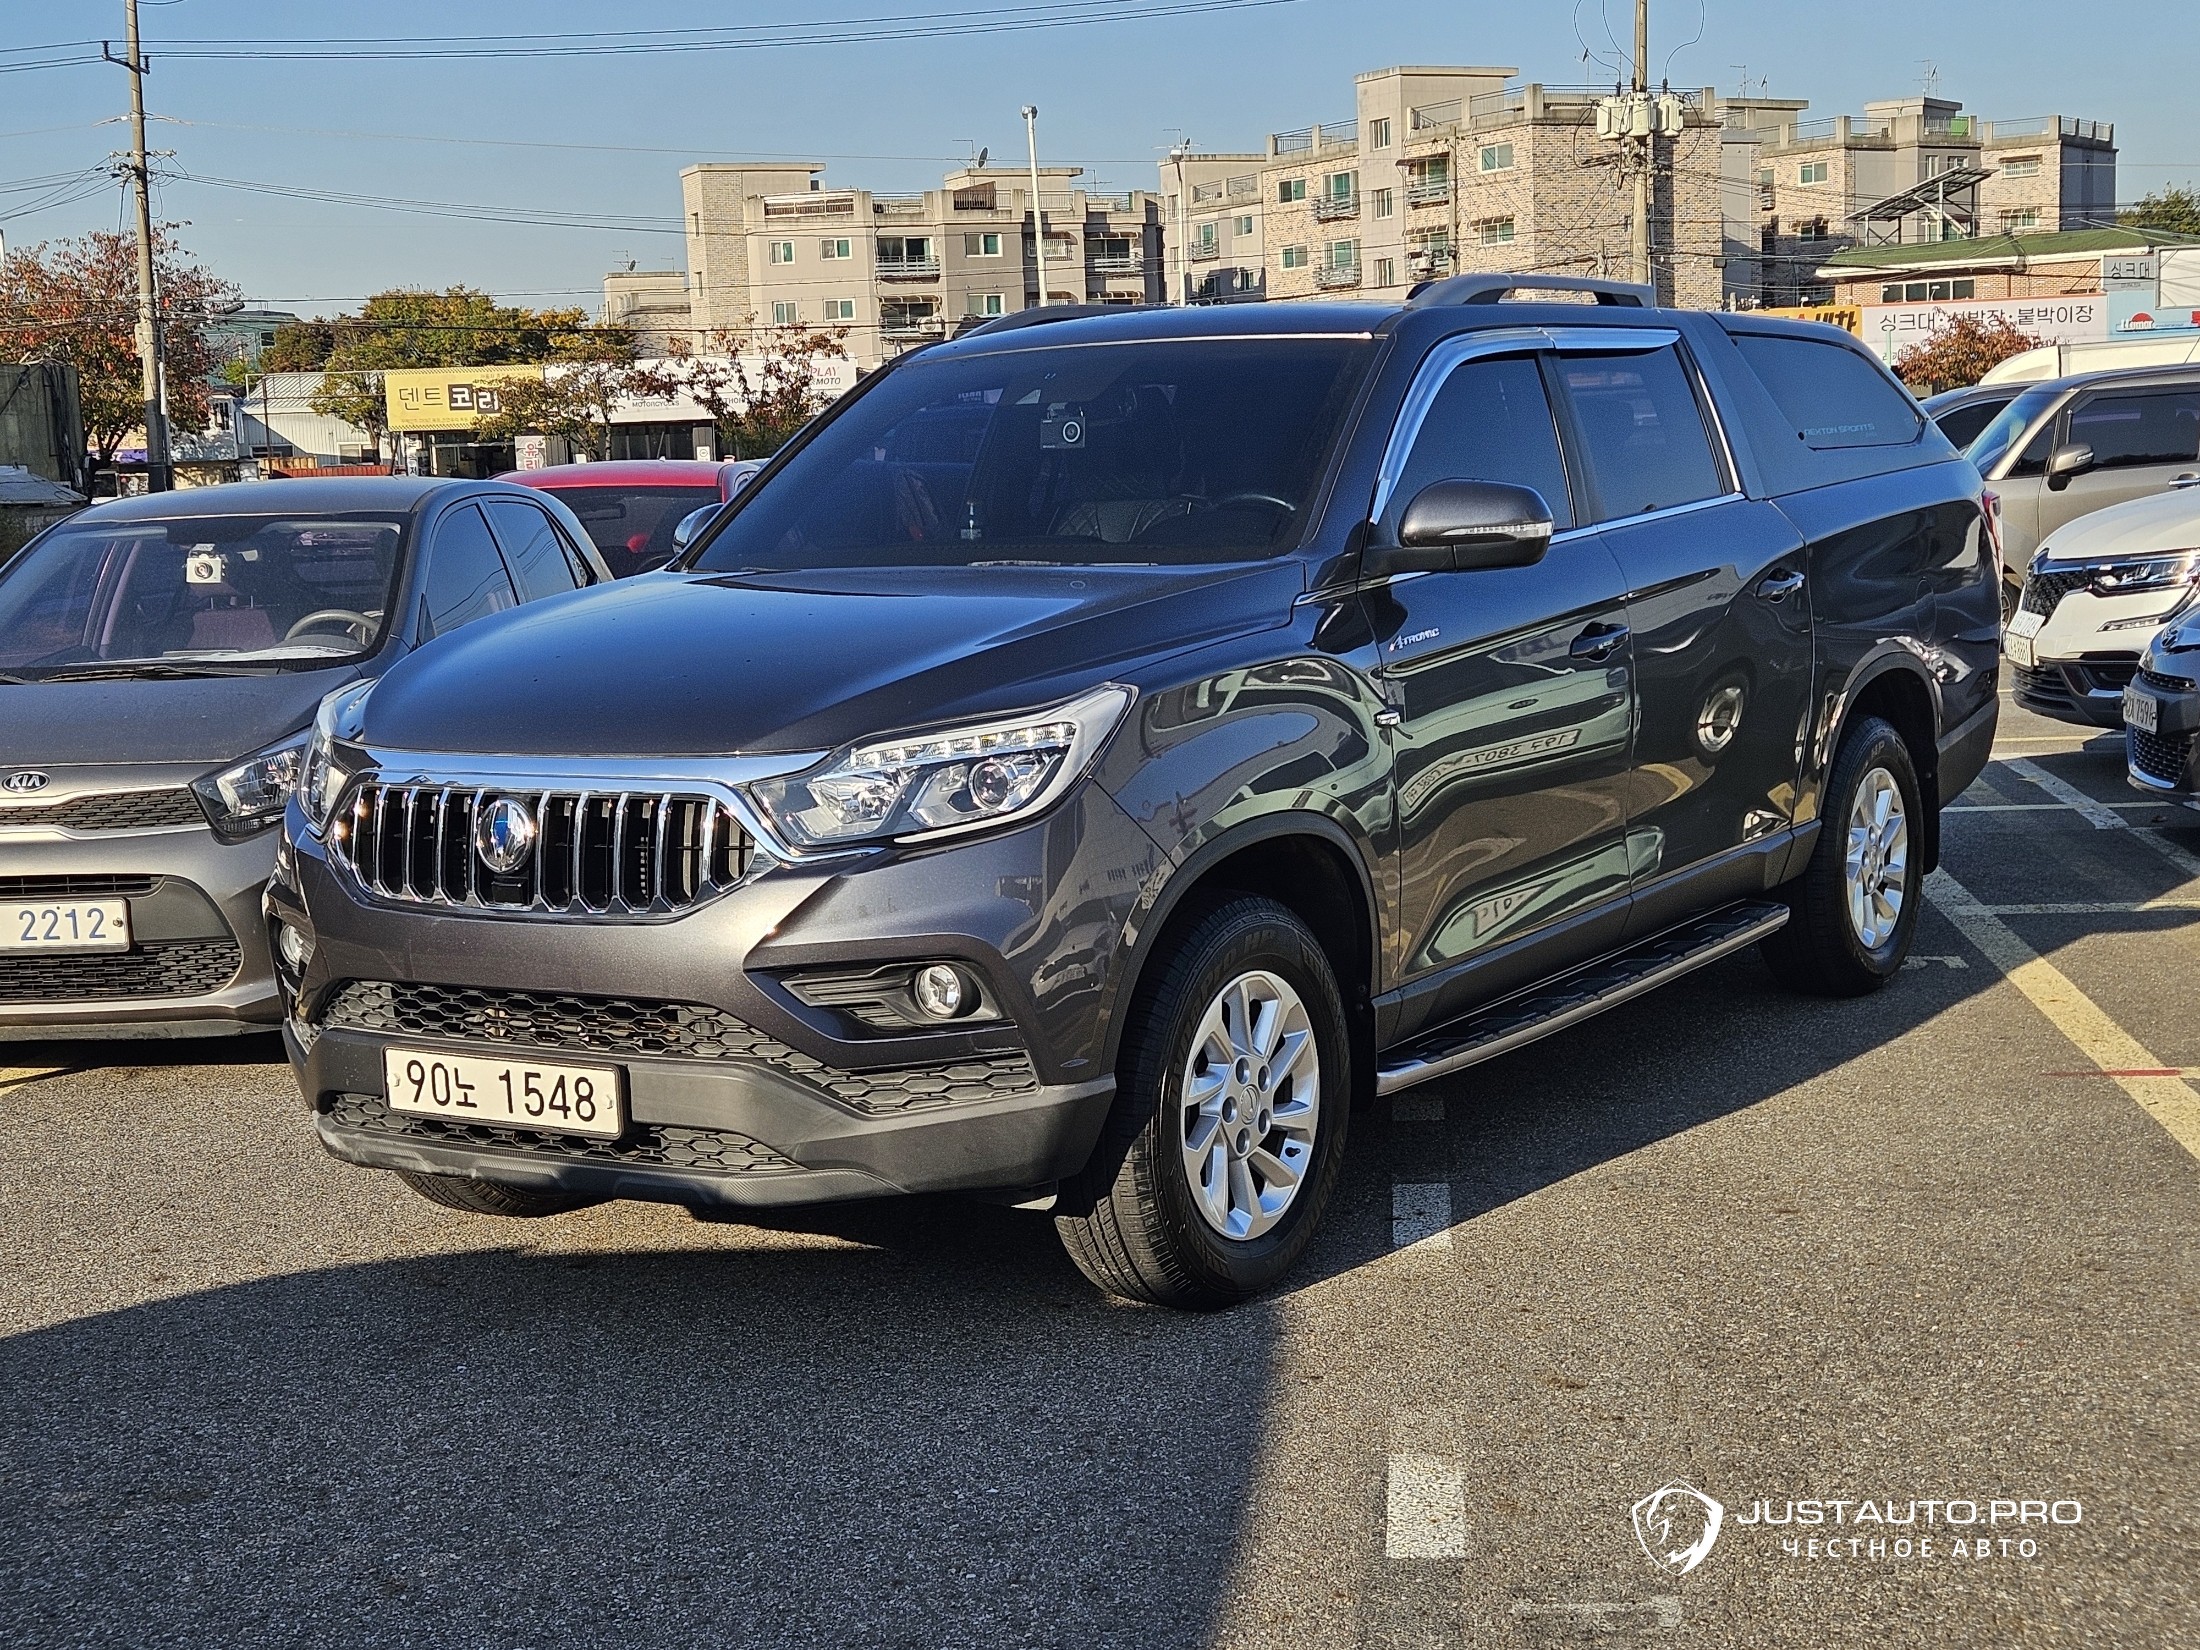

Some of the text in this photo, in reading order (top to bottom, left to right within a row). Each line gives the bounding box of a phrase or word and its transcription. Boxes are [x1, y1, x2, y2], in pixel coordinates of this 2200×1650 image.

[2111, 261, 2150, 279] 싱크대
[399, 387, 499, 411] 덴트 코리
[9, 773, 41, 789] KIA
[18, 907, 107, 941] 2212
[406, 1059, 597, 1122] 90노 1548
